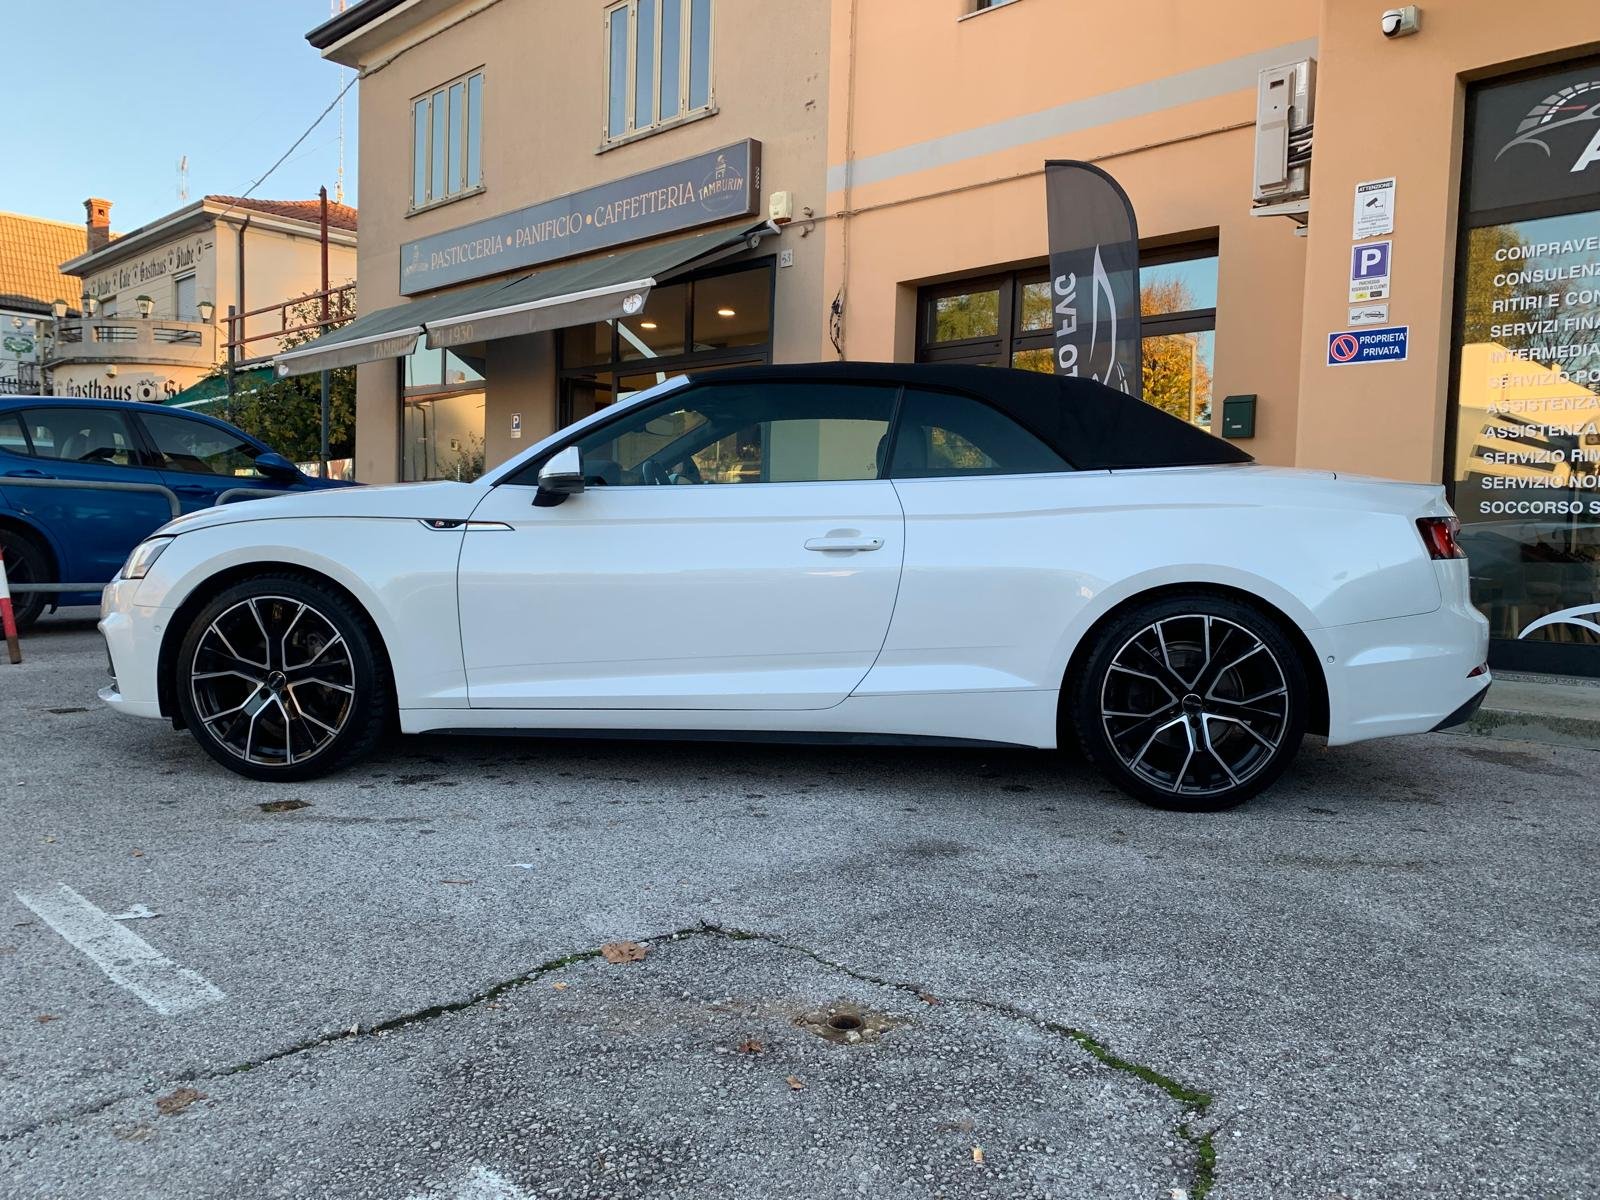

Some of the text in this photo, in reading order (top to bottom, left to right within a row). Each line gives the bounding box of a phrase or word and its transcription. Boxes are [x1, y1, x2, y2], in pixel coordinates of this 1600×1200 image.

[698, 177, 743, 201] TAMBURIN
[431, 181, 695, 269] PASTICCERIA PANIFICIO CAFFETTERIA
[1495, 236, 1600, 262] COMPRAVE
[1360, 249, 1381, 276] P
[1492, 296, 1542, 313] RITIRI
[1548, 293, 1560, 307] E
[1490, 320, 1558, 338] SERVIZI
[1360, 333, 1408, 345] PROPRIETA'
[1363, 346, 1400, 357] PRIVATA
[1491, 343, 1600, 363] INTERMEDIA
[1489, 371, 1569, 389] SERVIZIO
[67, 378, 132, 401] Gasthaus
[1487, 396, 1599, 414] ASSISTENZA
[513, 415, 520, 428] P
[1486, 422, 1598, 439] ASSISTENZA
[1483, 449, 1565, 464] SERVIZIO
[1481, 474, 1564, 489] SERVIZIO
[1480, 501, 1583, 514] SOCCORSO
